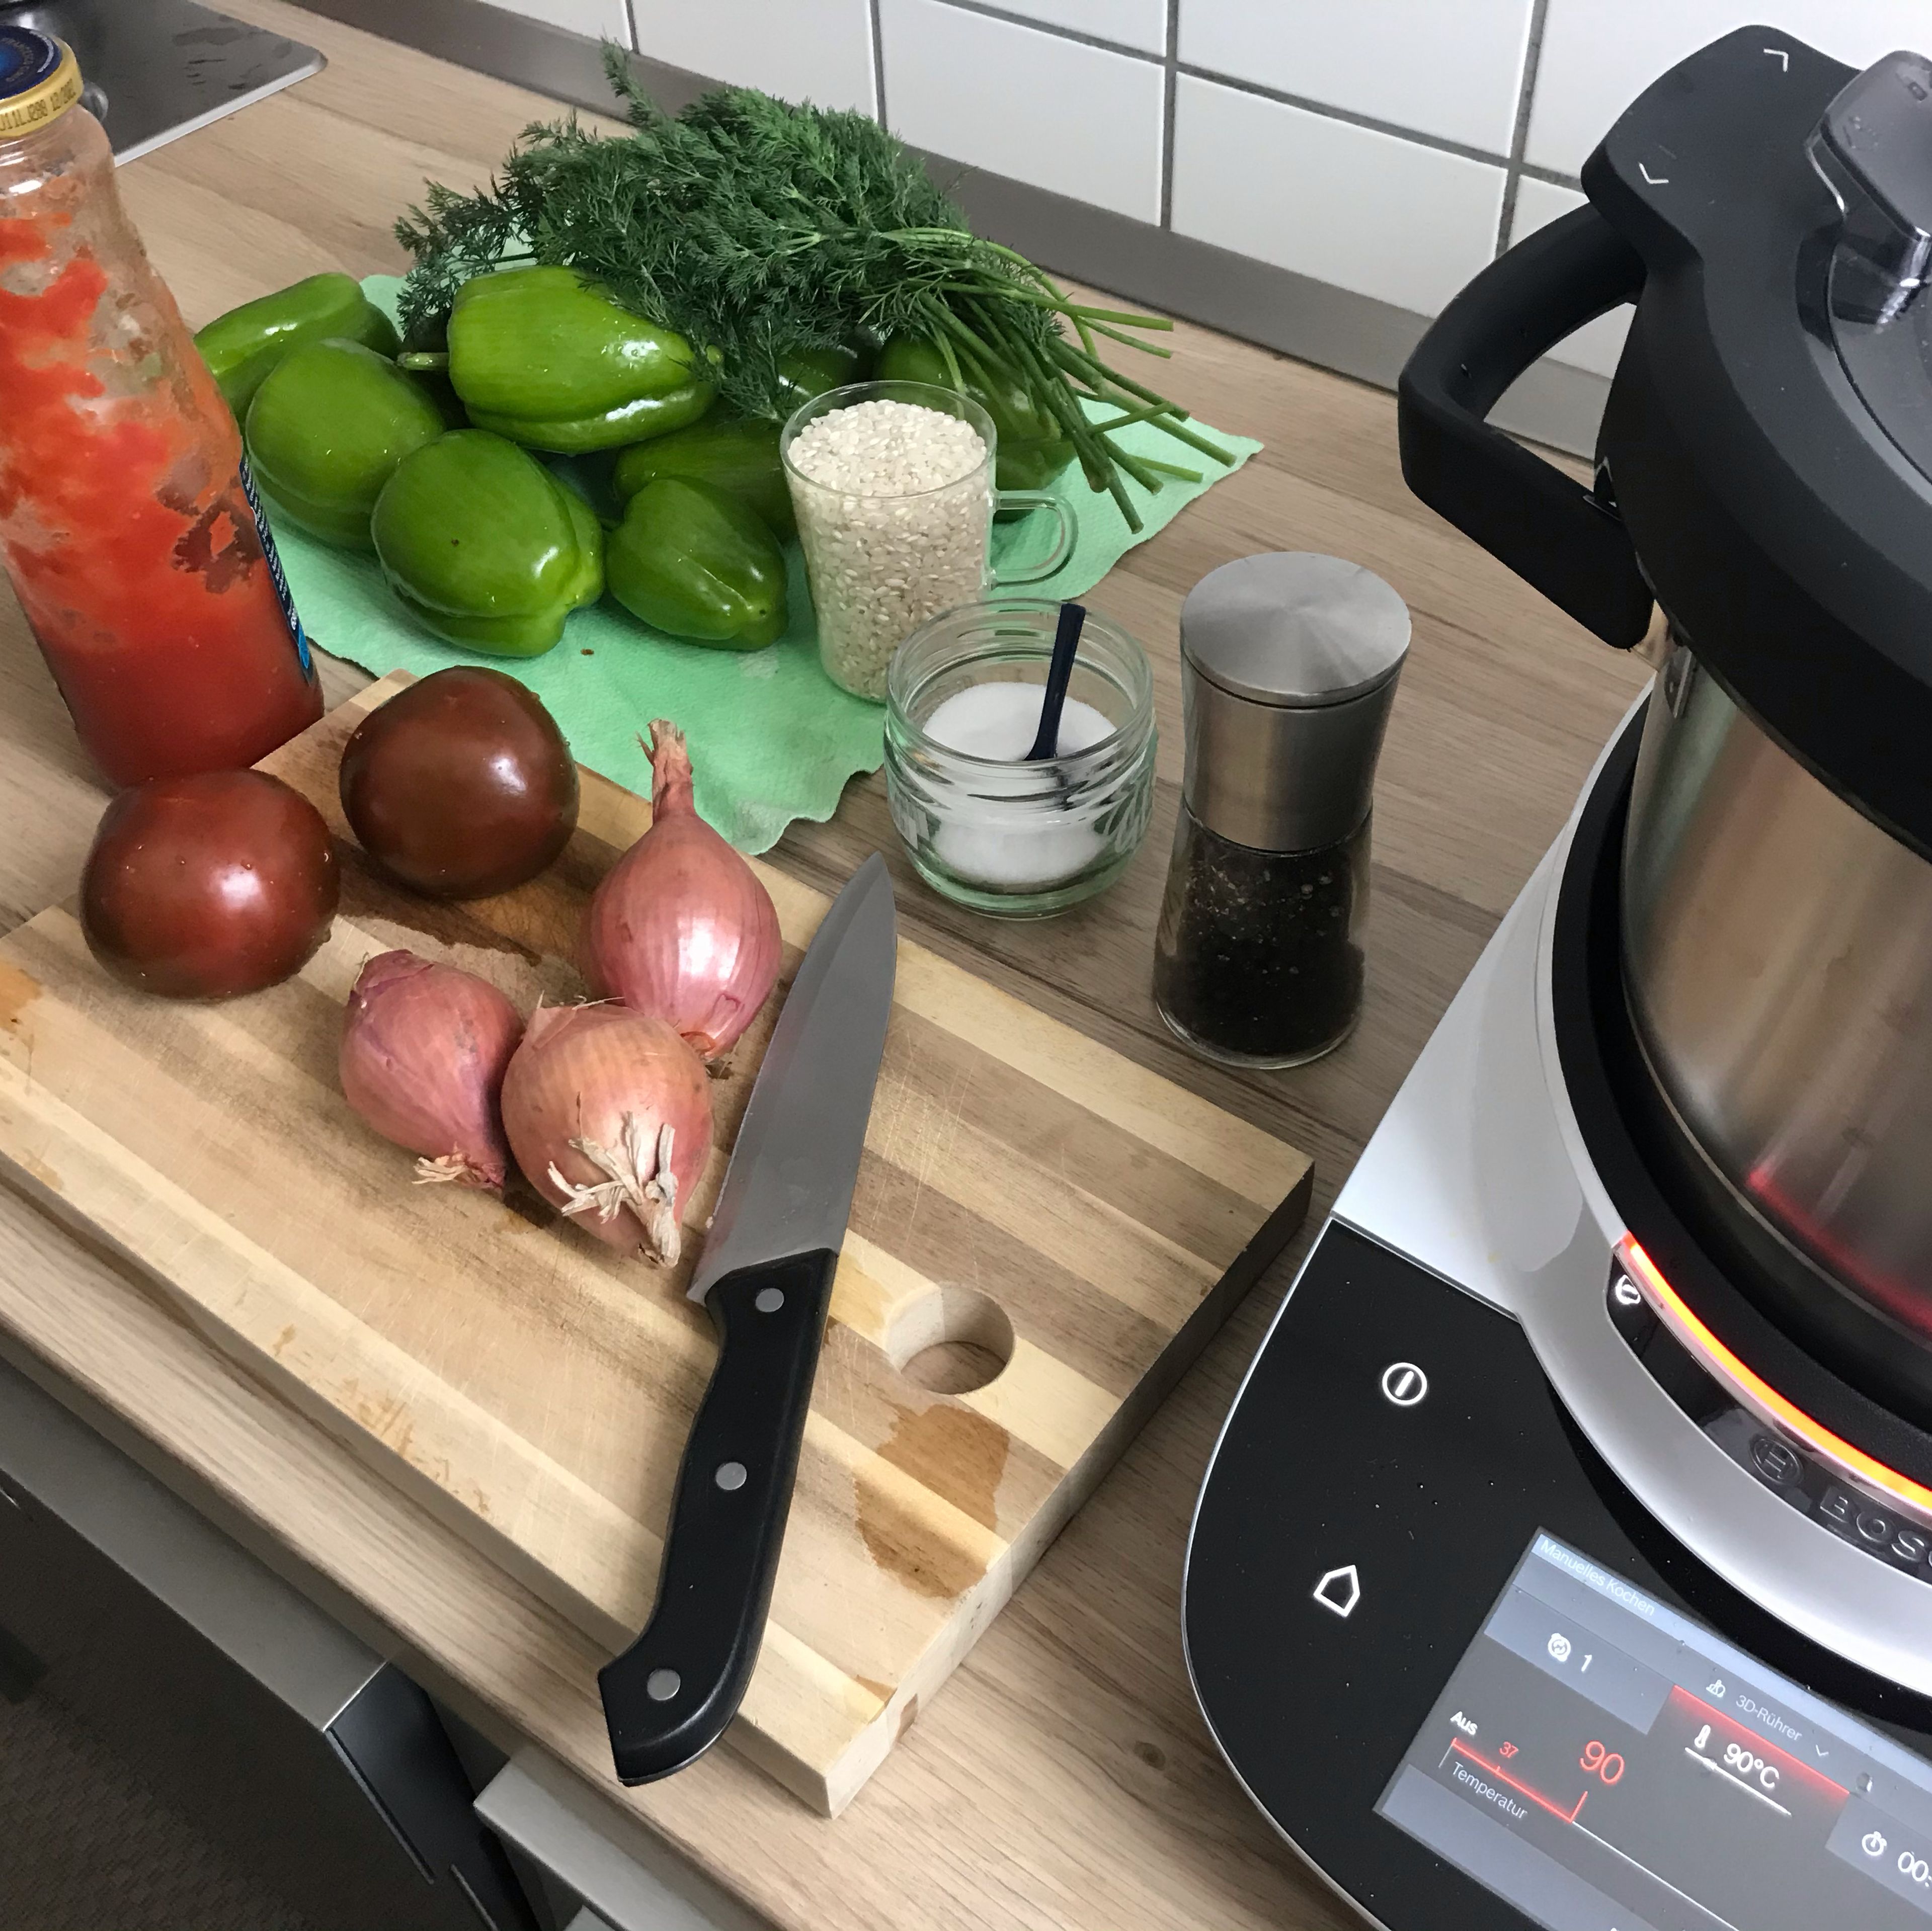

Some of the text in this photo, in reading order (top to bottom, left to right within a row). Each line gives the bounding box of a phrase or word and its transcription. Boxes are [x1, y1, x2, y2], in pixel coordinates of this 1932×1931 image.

[1540, 1539, 1655, 1616] Manuelles Kochen
[1581, 1654, 1592, 1671] 1
[1450, 1711, 1478, 1735] Aus
[1736, 1695, 1802, 1740] 3D-Rührer
[1499, 1741, 1518, 1758] 37
[1579, 1739, 1625, 1784] 90
[1723, 1743, 1780, 1788] 90°C
[1451, 1761, 1528, 1819] Temperatur
